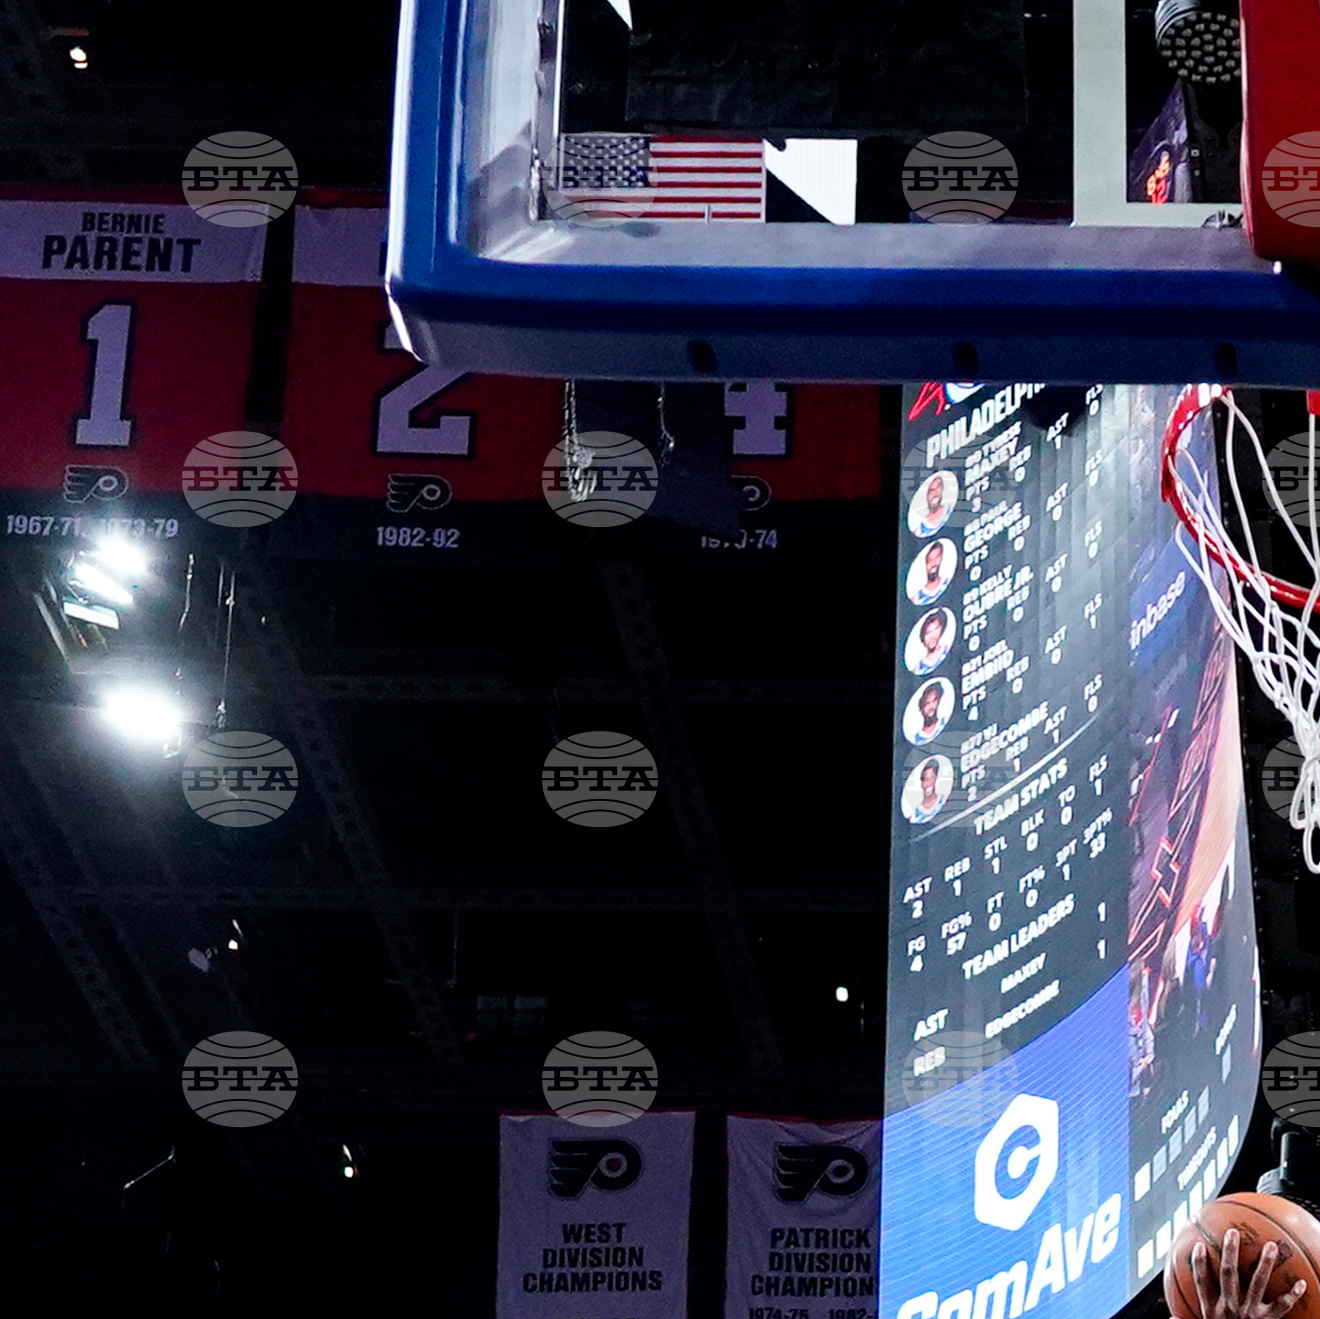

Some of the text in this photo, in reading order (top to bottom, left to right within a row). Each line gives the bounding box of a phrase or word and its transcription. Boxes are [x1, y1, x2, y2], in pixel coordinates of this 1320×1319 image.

[81, 211, 166, 234] BERNIE
[41, 234, 201, 273] PARENT
[76, 304, 133, 446] 1
[376, 526, 462, 549] 1982-92
[973, 757, 1068, 836] TEAM STATS
[902, 754, 1107, 904] AST REB STL BLK TO FLS
[962, 893, 1075, 980] TEAM LEADERS
[913, 1009, 949, 1042] AST
[562, 1223, 627, 1244] WEST
[770, 1227, 872, 1249] PATRICK
[542, 1247, 645, 1269] DIVISION
[768, 1251, 872, 1274] DIVISION
[522, 1270, 663, 1294] CHAMPIONS
[750, 1273, 878, 1298] CHAMPION
